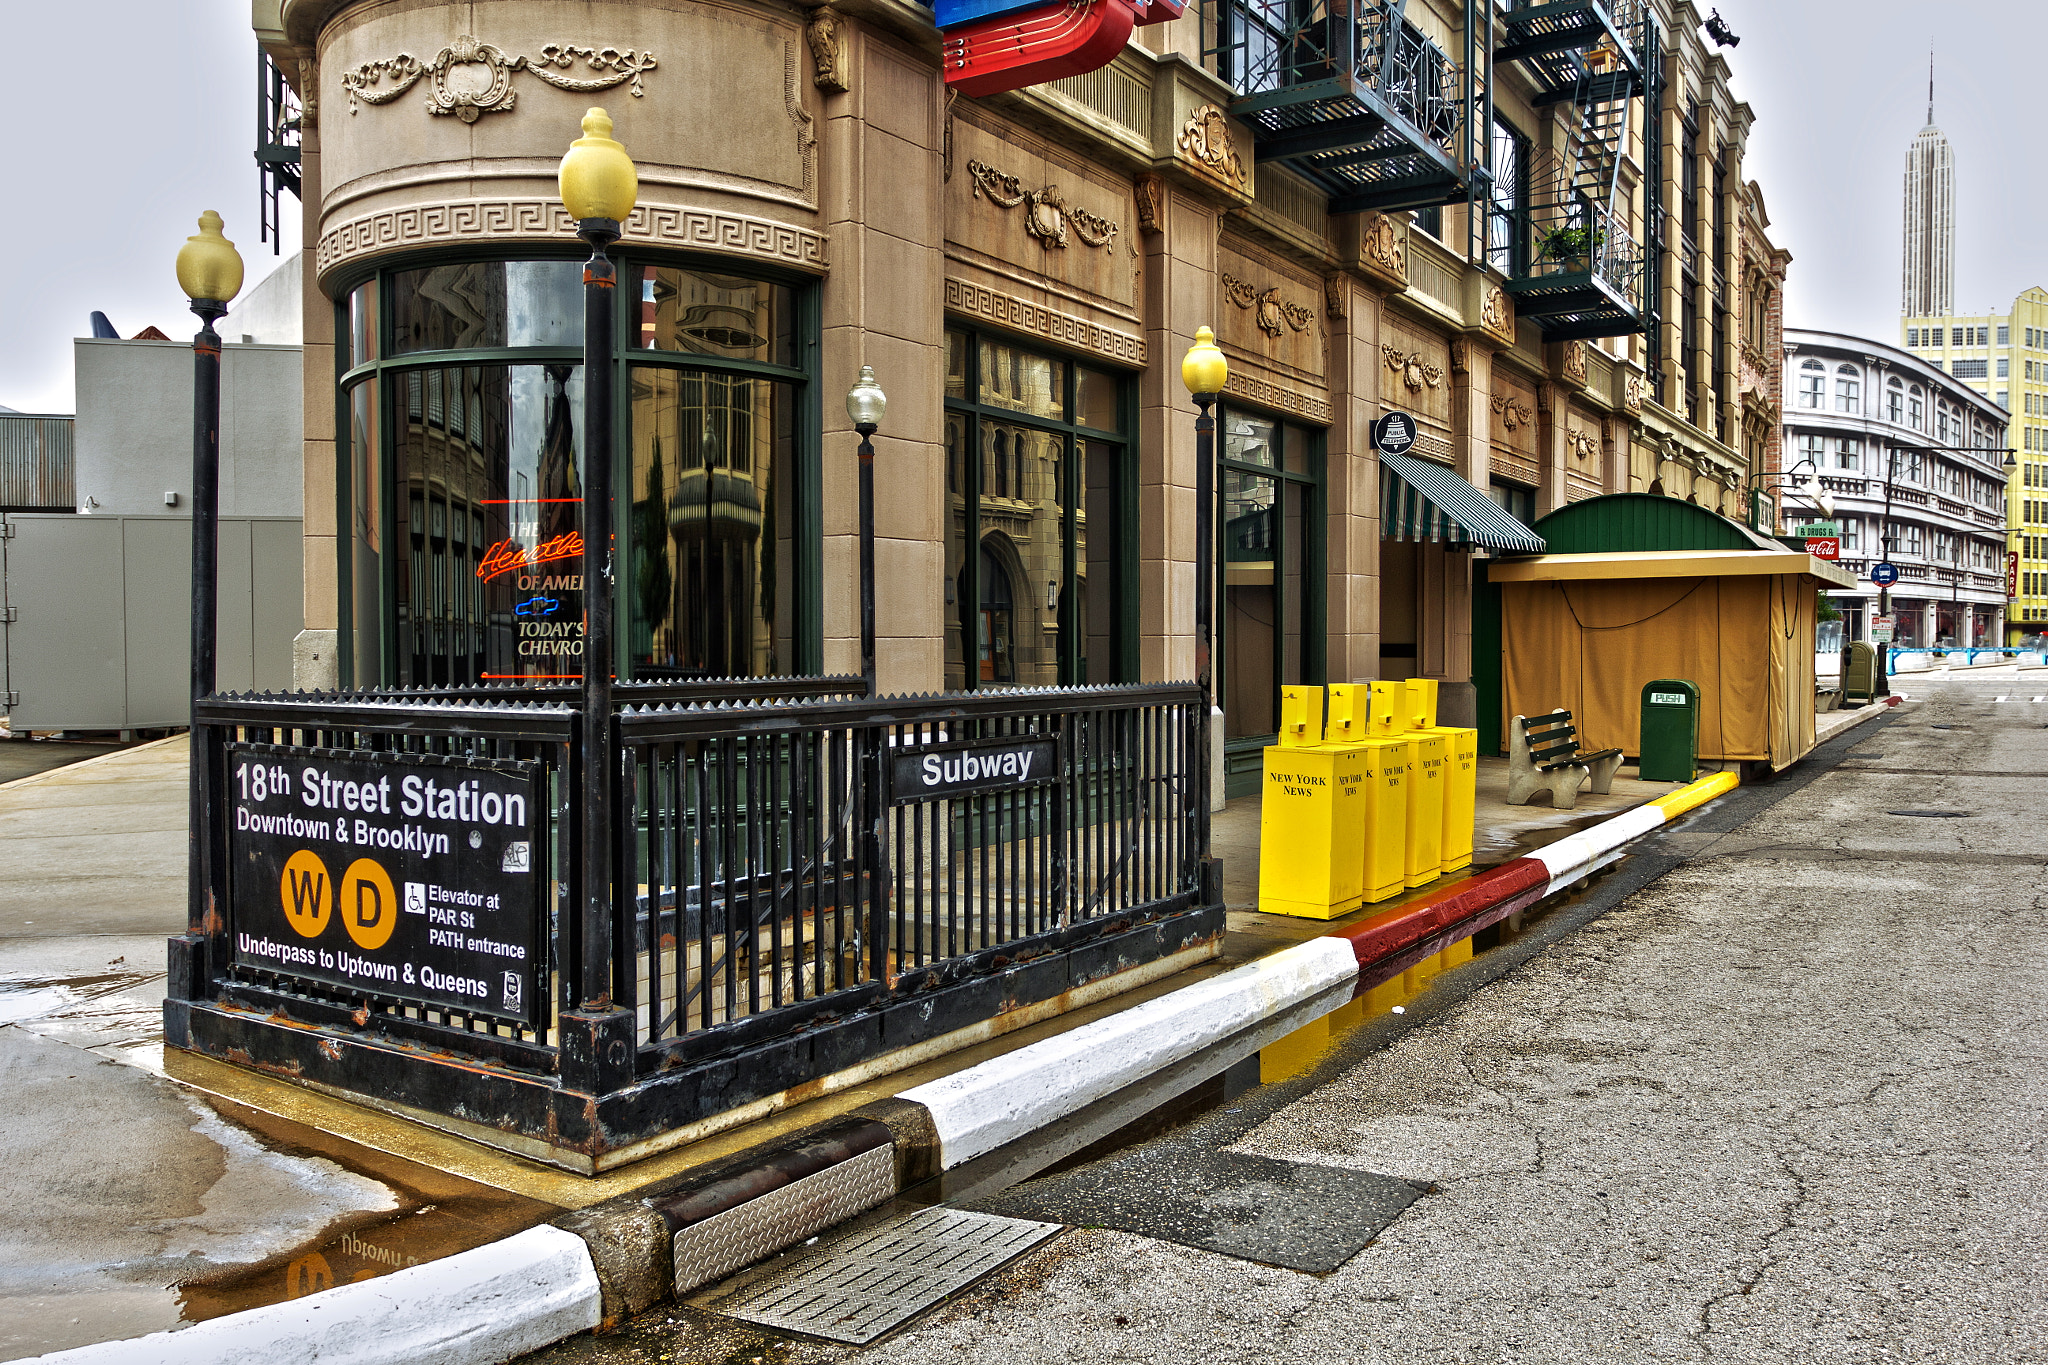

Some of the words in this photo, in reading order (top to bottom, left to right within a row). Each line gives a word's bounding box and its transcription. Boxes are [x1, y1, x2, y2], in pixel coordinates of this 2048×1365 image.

[510, 522, 540, 536] THE
[1807, 527, 1827, 536] DRUGS
[476, 531, 584, 577] Heartbe
[518, 575, 540, 591] OF
[519, 622, 584, 637] TODAY'S
[518, 641, 584, 656] CHEVRO
[1655, 693, 1681, 703] PUSH
[921, 751, 1033, 786] Subway
[1270, 772, 1293, 783] NEW
[1297, 774, 1326, 786] YORK
[1338, 776, 1349, 786] NEW
[1349, 774, 1363, 784] YORK
[236, 763, 291, 801] 18th
[302, 767, 391, 815] Street
[401, 774, 525, 827] Station
[1283, 785, 1312, 797] NEWS
[1344, 787, 1357, 797] NEWS
[237, 806, 330, 841] Downtown
[335, 817, 349, 844] &
[354, 819, 450, 859] Brooklyn
[288, 868, 324, 919] W
[356, 878, 382, 928] D
[428, 884, 484, 908] Elevator
[486, 893, 500, 910] at
[429, 906, 457, 926] PAR
[460, 910, 475, 929] St
[429, 928, 464, 949] PATH
[467, 937, 526, 960] entrance
[239, 932, 317, 964] Underpass
[319, 947, 334, 969] to
[337, 950, 398, 982] Uptown
[402, 962, 416, 985] &
[420, 965, 488, 998] Queens
